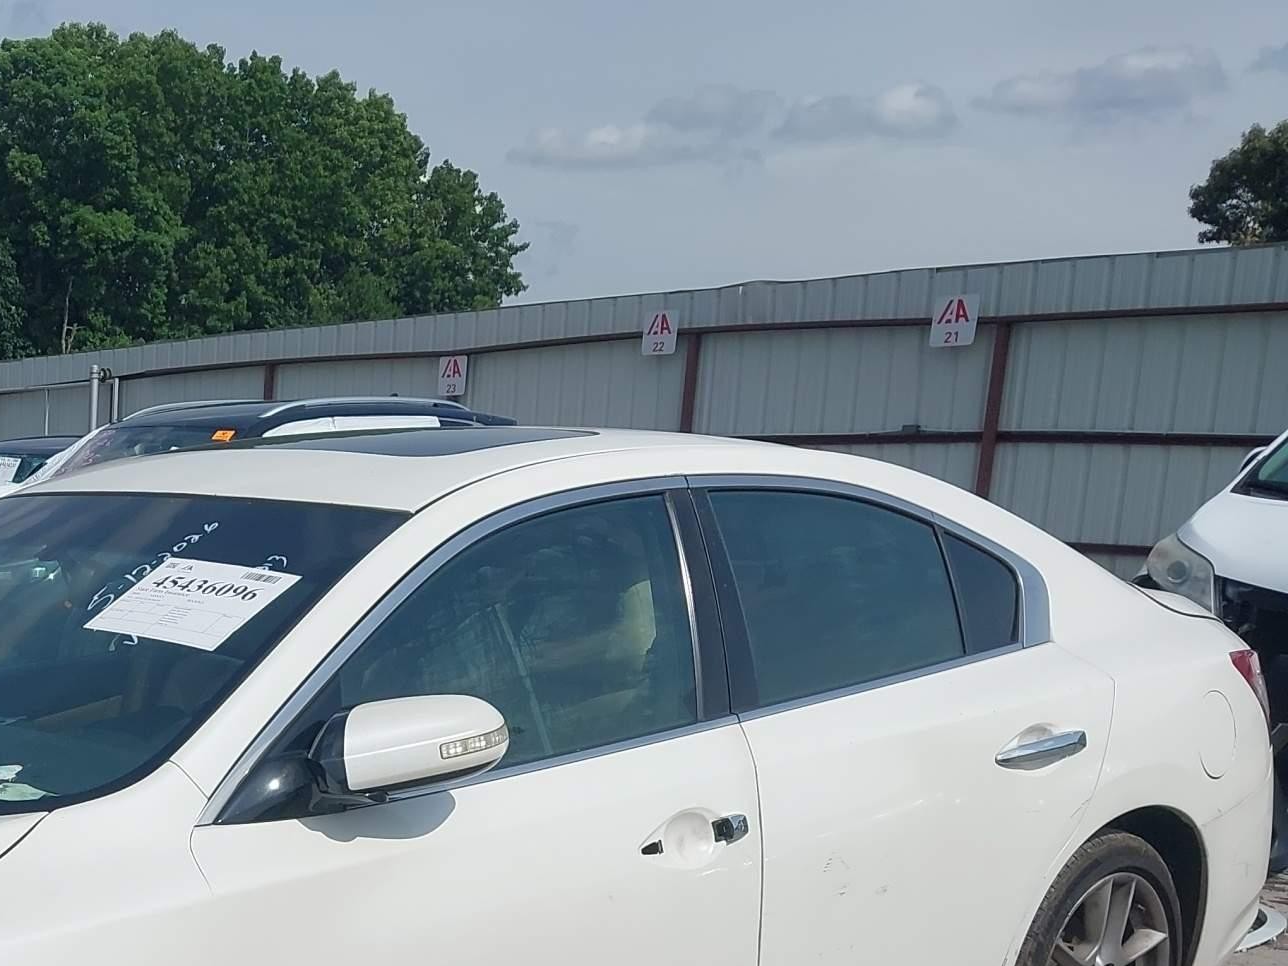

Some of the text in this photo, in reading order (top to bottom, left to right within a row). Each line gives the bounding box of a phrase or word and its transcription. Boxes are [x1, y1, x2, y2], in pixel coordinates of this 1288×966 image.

[943, 331, 959, 344] 21
[652, 341, 665, 352] 22
[446, 384, 457, 394] 23
[152, 575, 264, 601] 45436096
